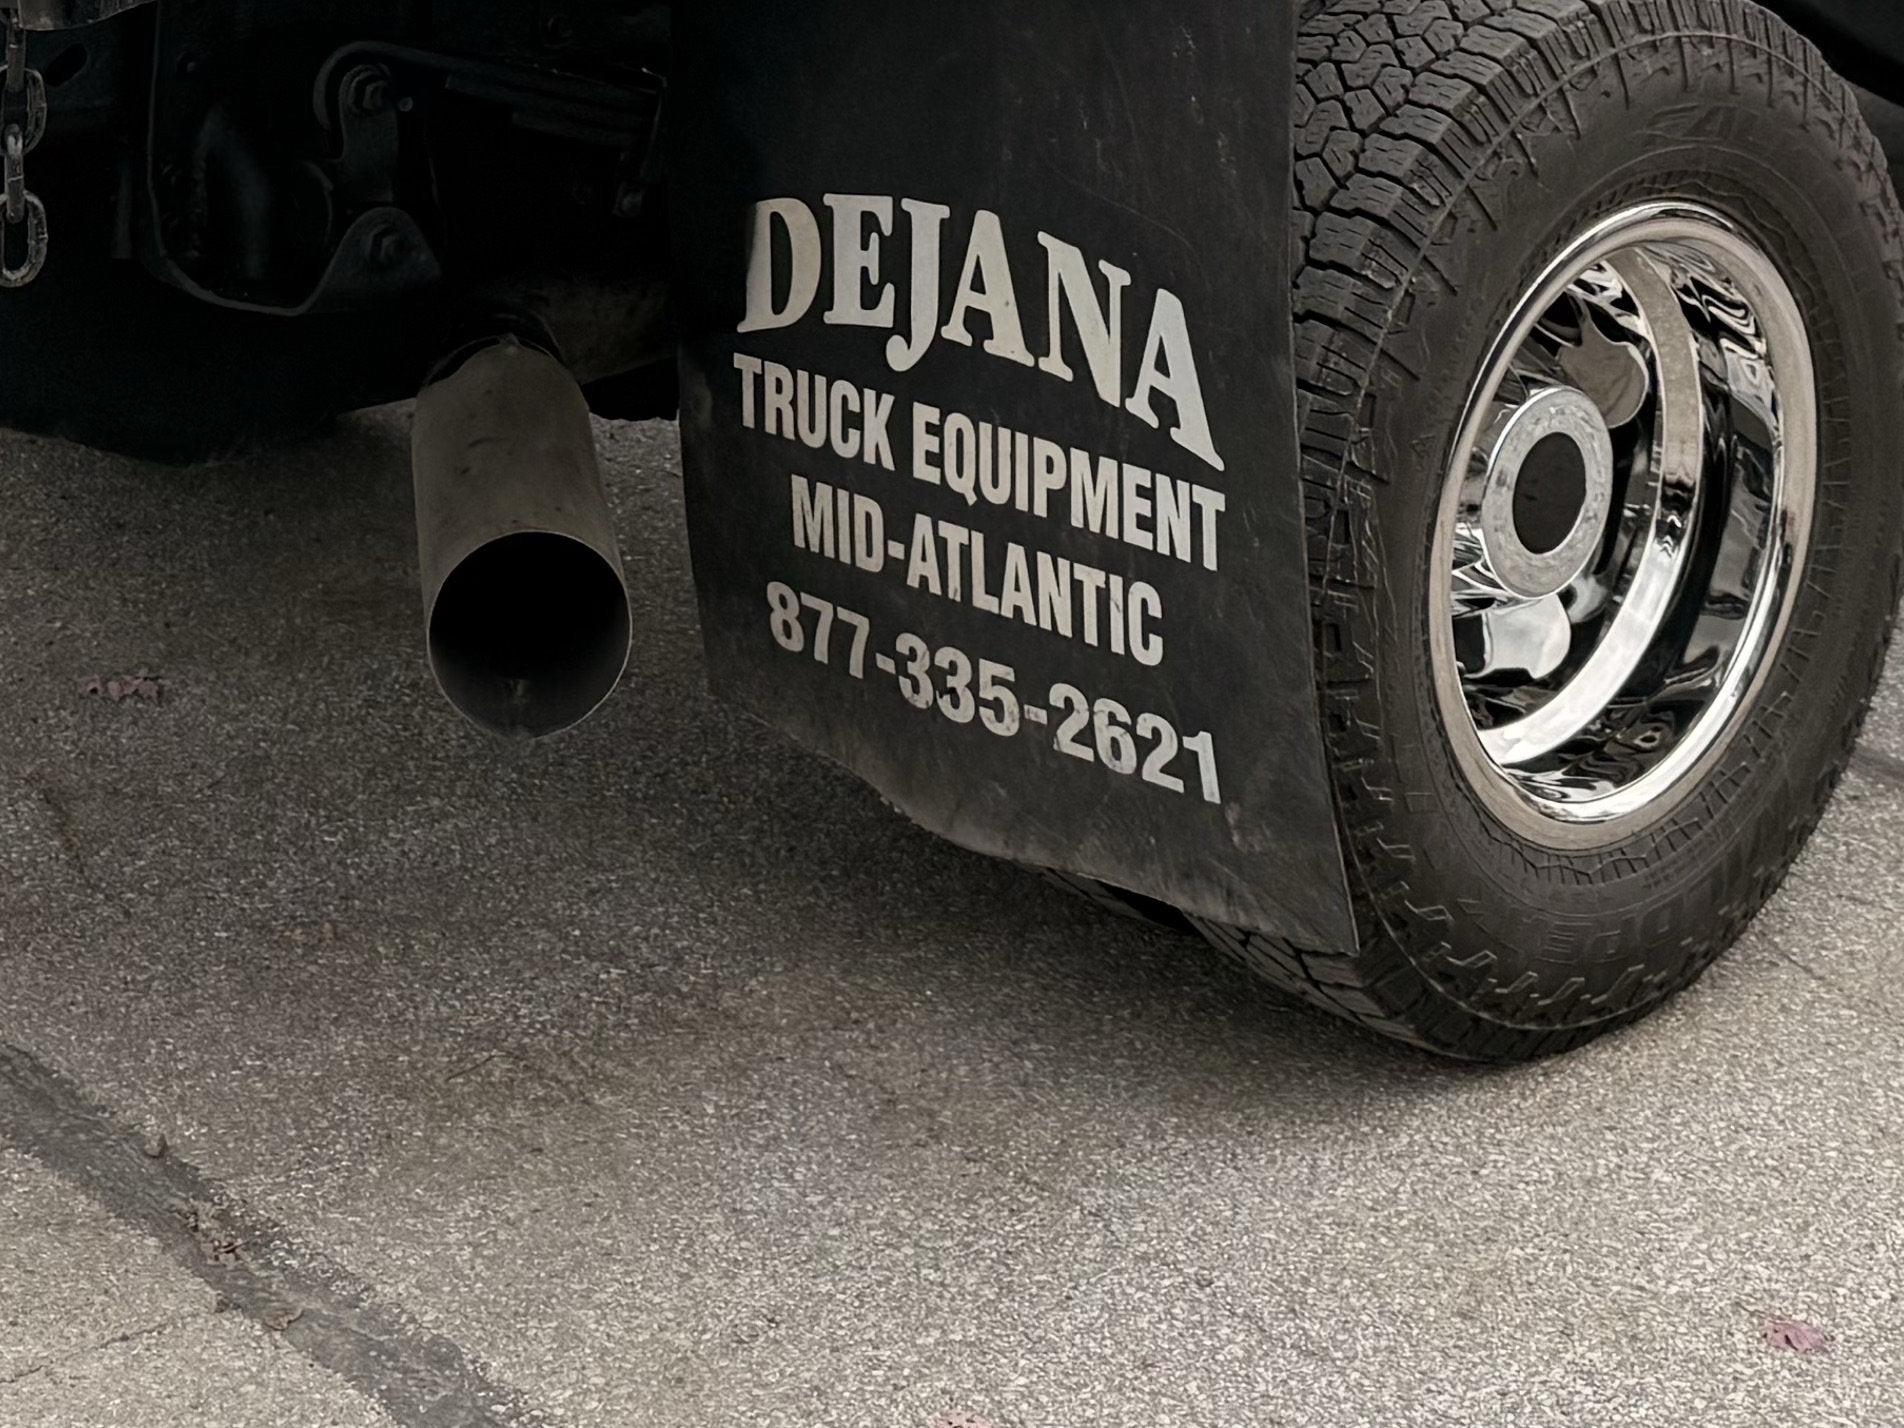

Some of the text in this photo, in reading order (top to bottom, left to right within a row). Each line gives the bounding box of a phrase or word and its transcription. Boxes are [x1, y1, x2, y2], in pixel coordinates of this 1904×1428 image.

[737, 192, 1225, 472] DEJANA
[733, 353, 1226, 572] TRUCK EQUIPMENT
[790, 474, 1165, 667] MID-ATLANTIC
[766, 581, 1222, 805] 877-335-2621
